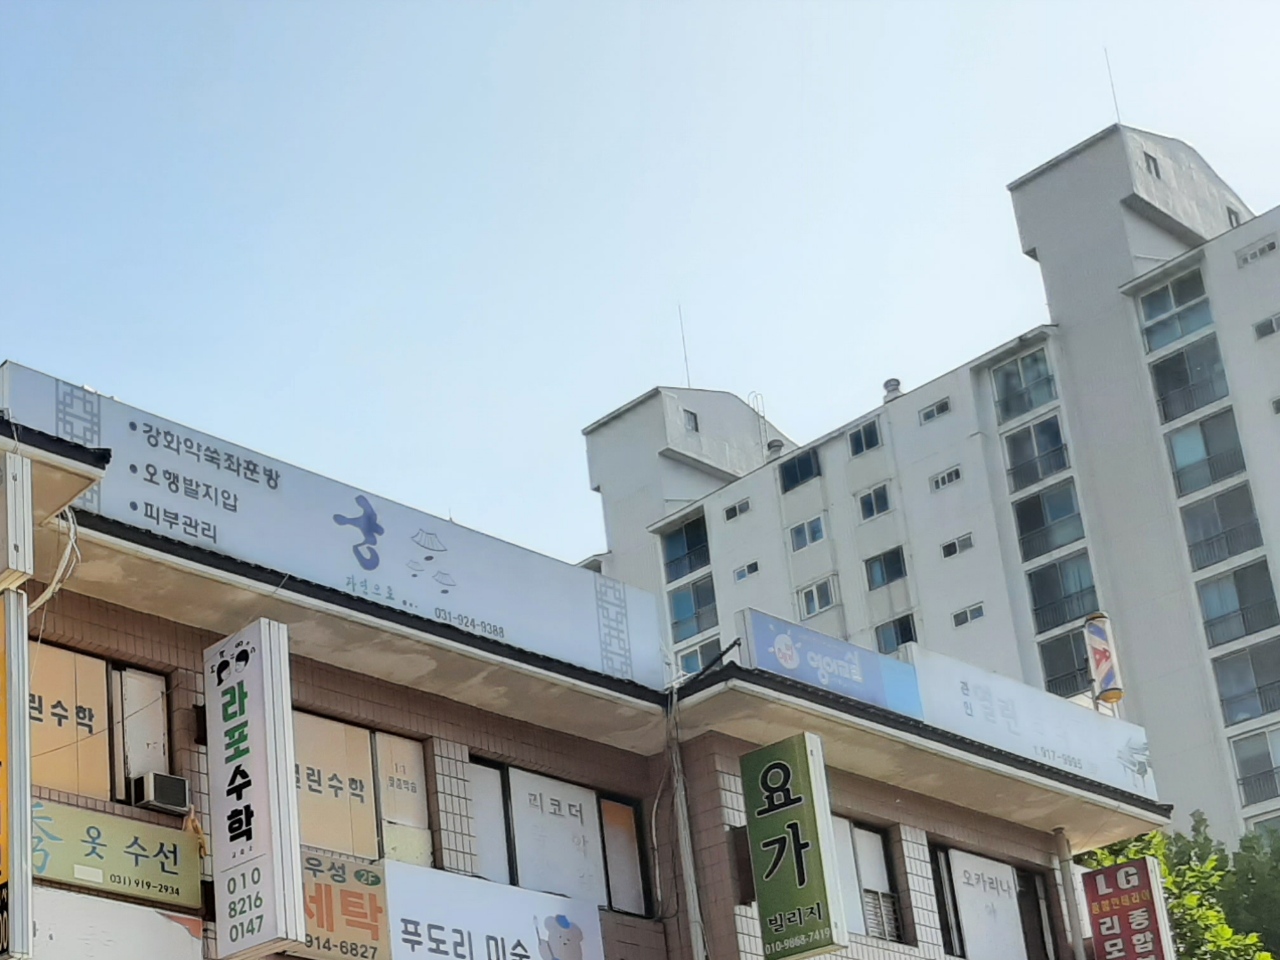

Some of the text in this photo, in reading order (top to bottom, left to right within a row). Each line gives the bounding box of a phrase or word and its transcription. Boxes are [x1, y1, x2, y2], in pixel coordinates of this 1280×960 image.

[141, 462, 240, 514] 오행발지압
[141, 501, 218, 545] 피부관리
[434, 607, 505, 639] 031-924-9388
[527, 791, 585, 828] 리코더
[756, 760, 811, 889] 요가
[80, 825, 179, 876] 옷 수선
[226, 866, 262, 896] 010
[304, 856, 347, 884] 우성
[1095, 866, 1140, 896] LG
[228, 891, 264, 920] 8216
[305, 883, 384, 941] 세탁
[768, 901, 822, 933] 빌리지
[228, 914, 265, 943] 0147
